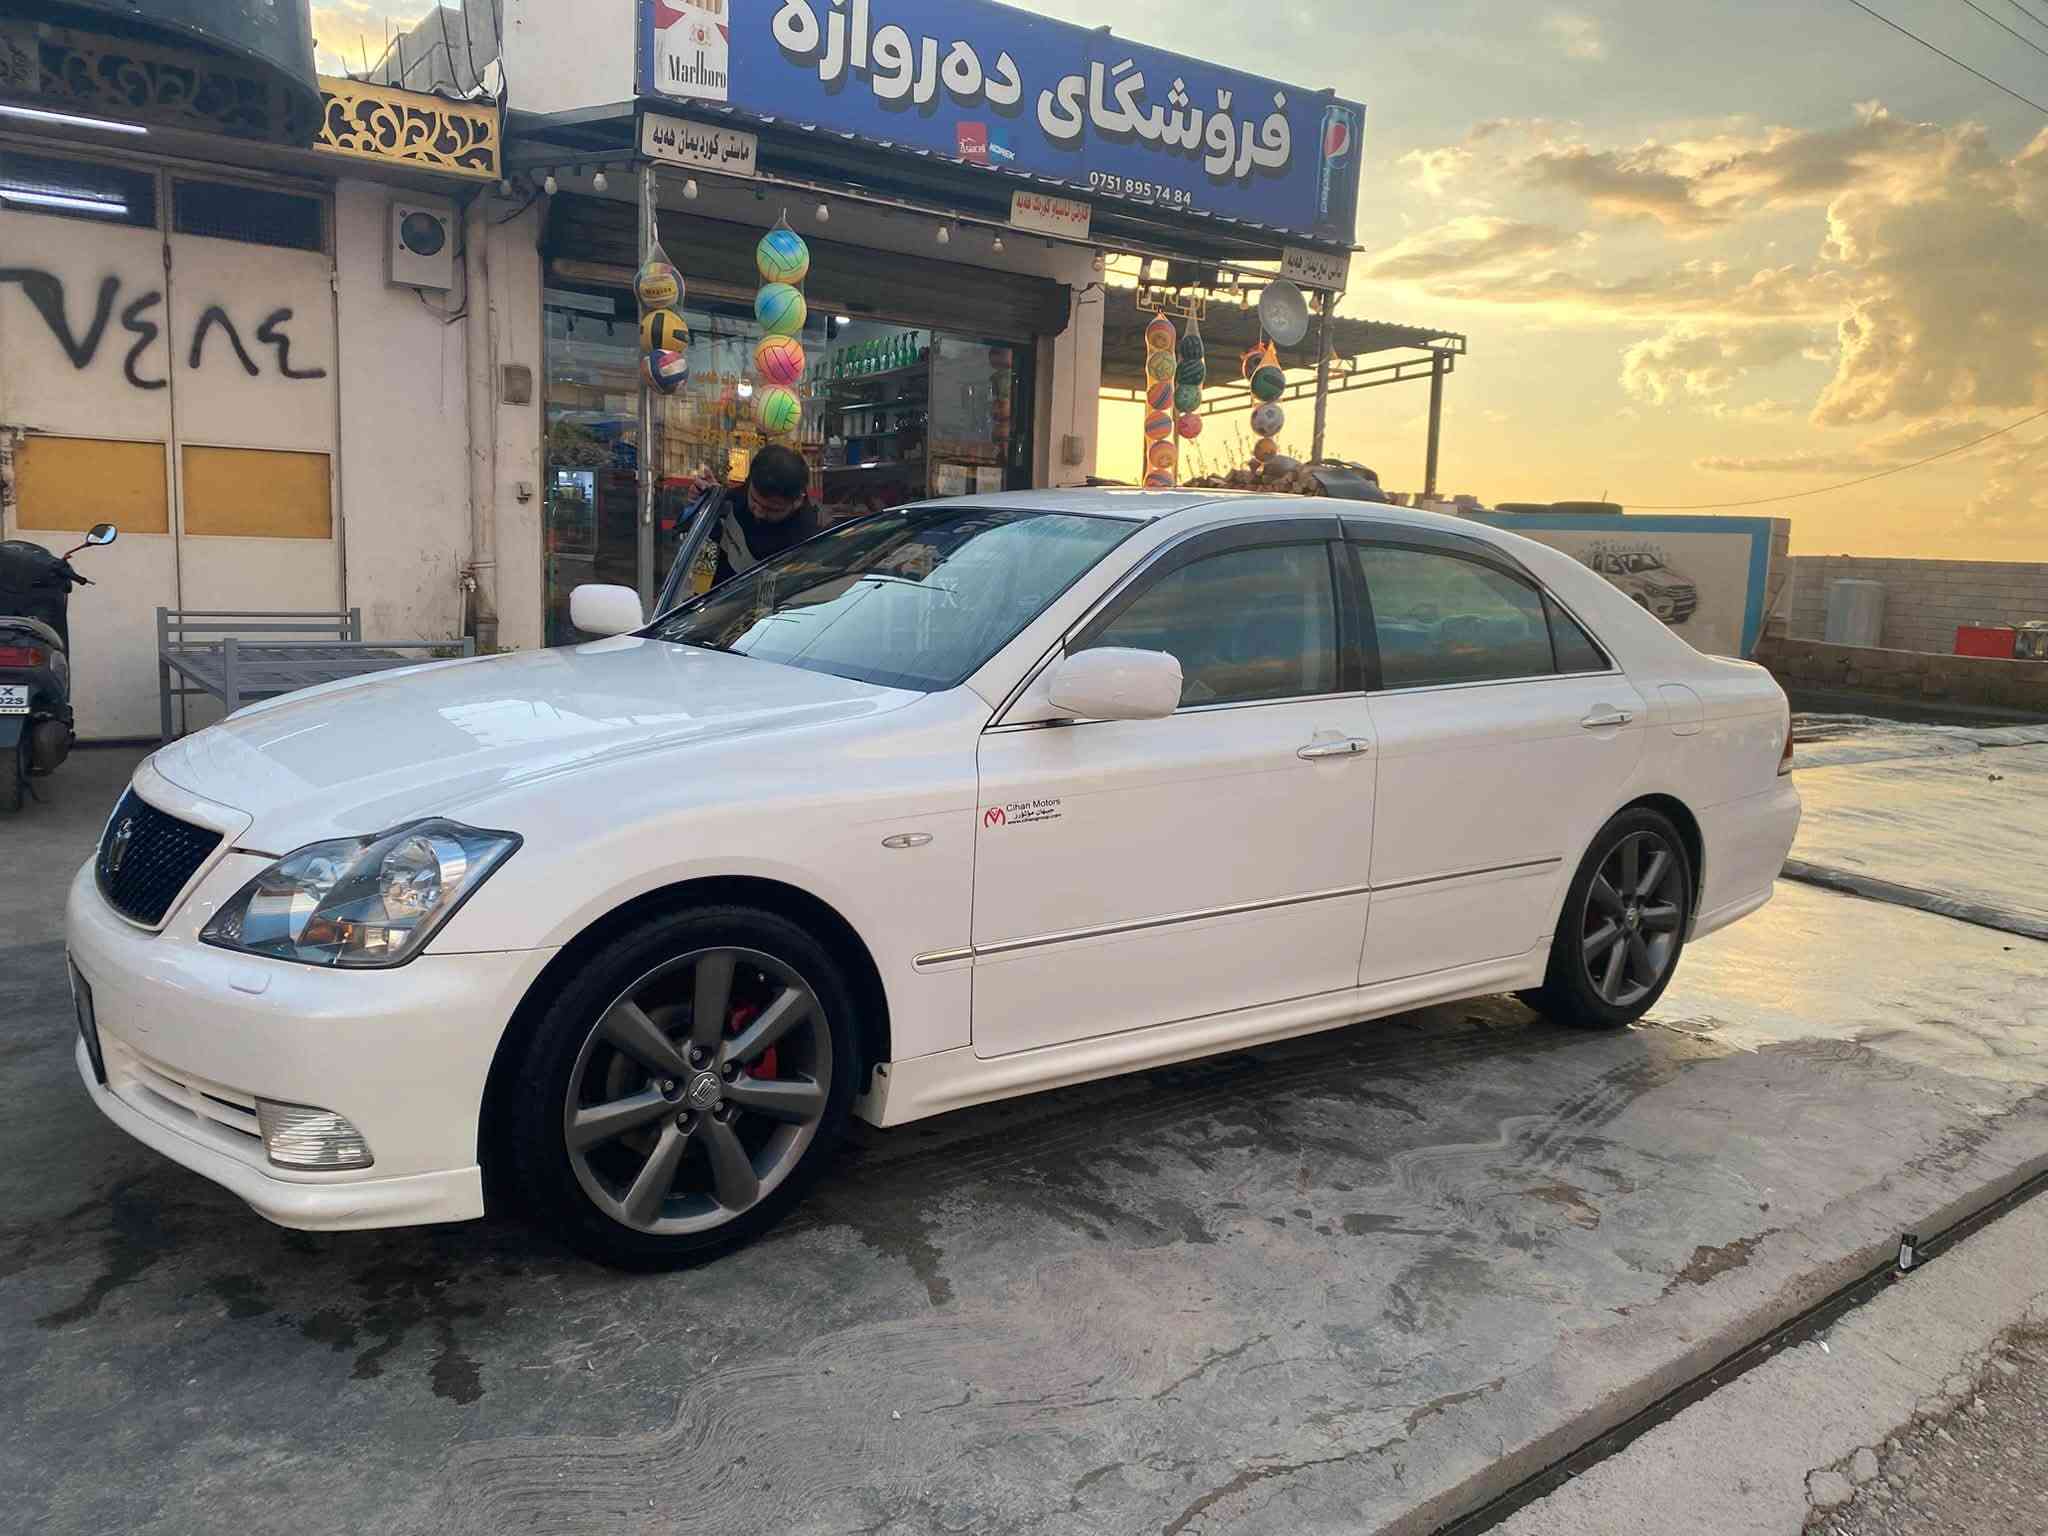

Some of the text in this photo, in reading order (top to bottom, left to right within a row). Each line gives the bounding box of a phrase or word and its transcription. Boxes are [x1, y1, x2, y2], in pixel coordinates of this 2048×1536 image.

[668, 50, 727, 88] Marlboro
[772, 0, 1291, 178] فرۆشگای دەروازە
[1089, 171, 1192, 206] 0751 895 74 84
[1006, 799, 1060, 812] Cihan Motors
